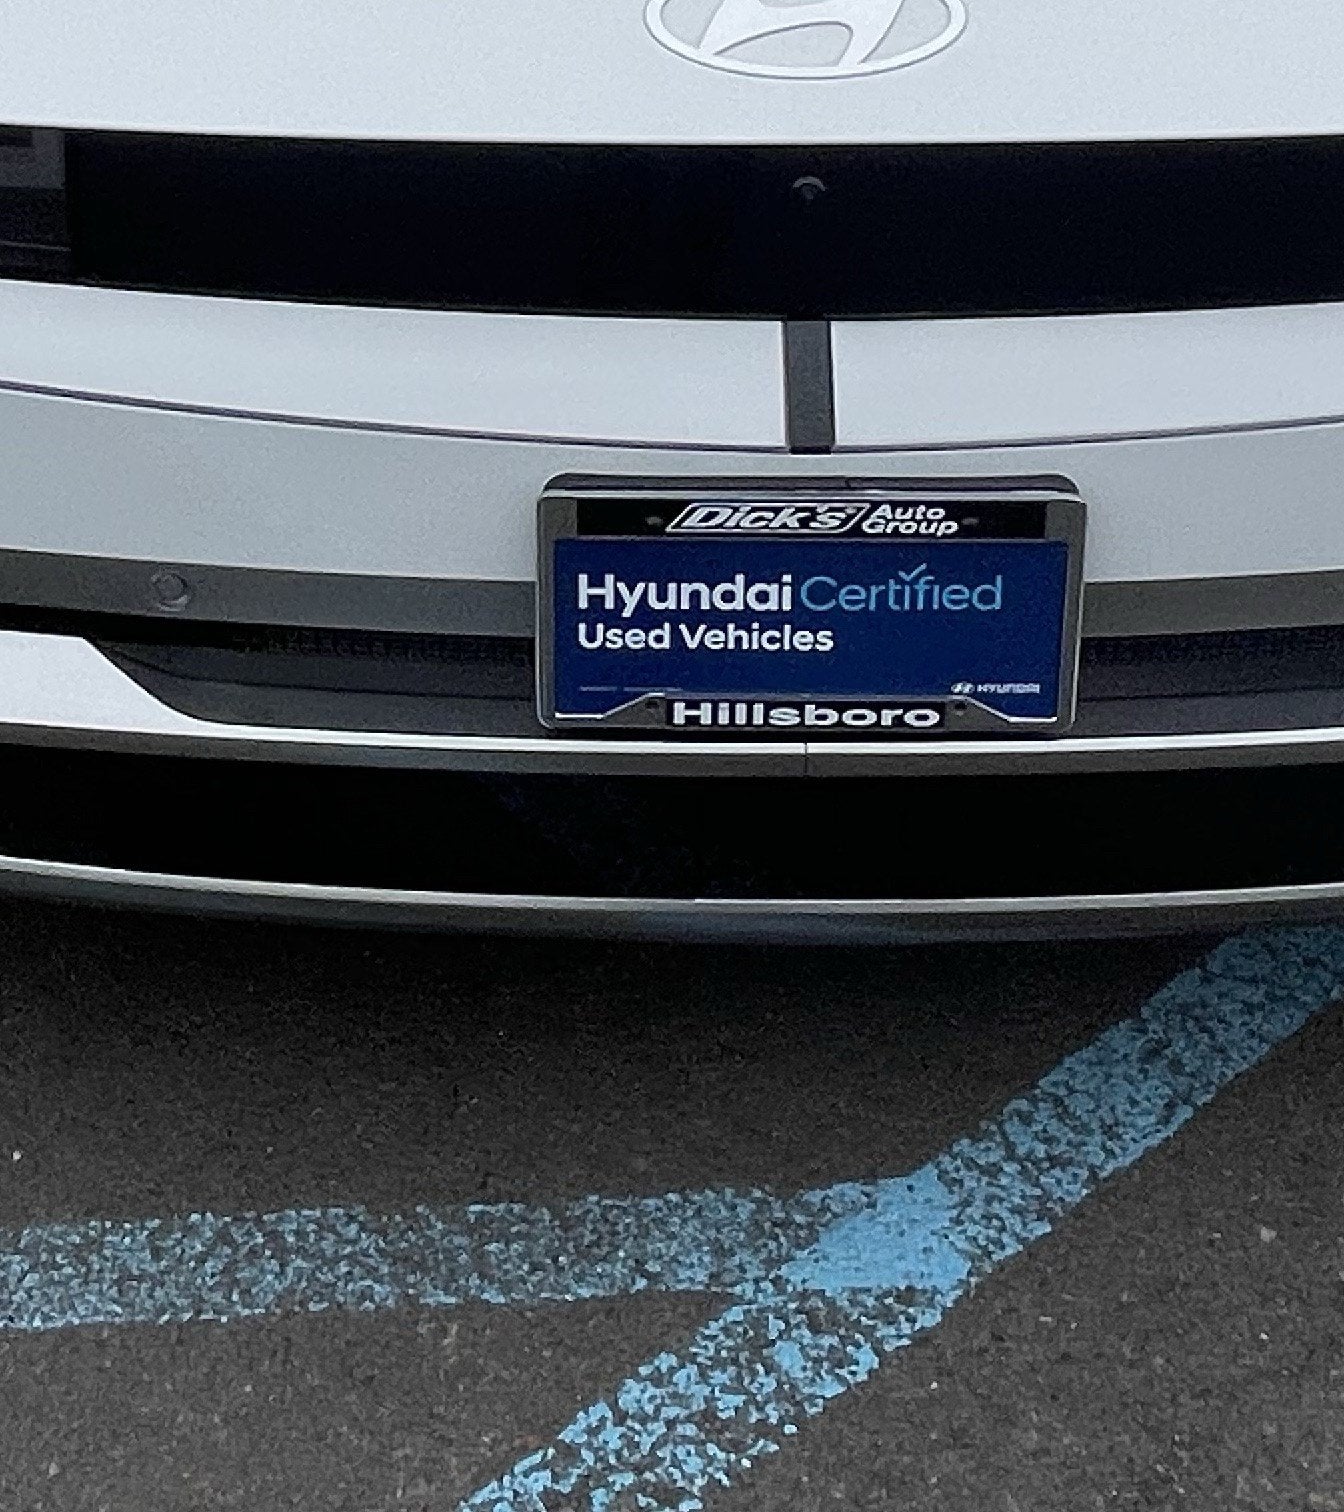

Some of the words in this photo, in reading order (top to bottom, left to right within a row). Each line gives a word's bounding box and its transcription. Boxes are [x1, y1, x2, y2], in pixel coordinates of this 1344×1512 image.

[868, 504, 946, 520] Auto
[862, 518, 959, 537] Group
[577, 574, 793, 618] Hyundai
[800, 564, 1002, 611] Certified
[578, 624, 672, 650] Used
[677, 624, 834, 651] Vehicles
[673, 702, 941, 727] Hillsboro
